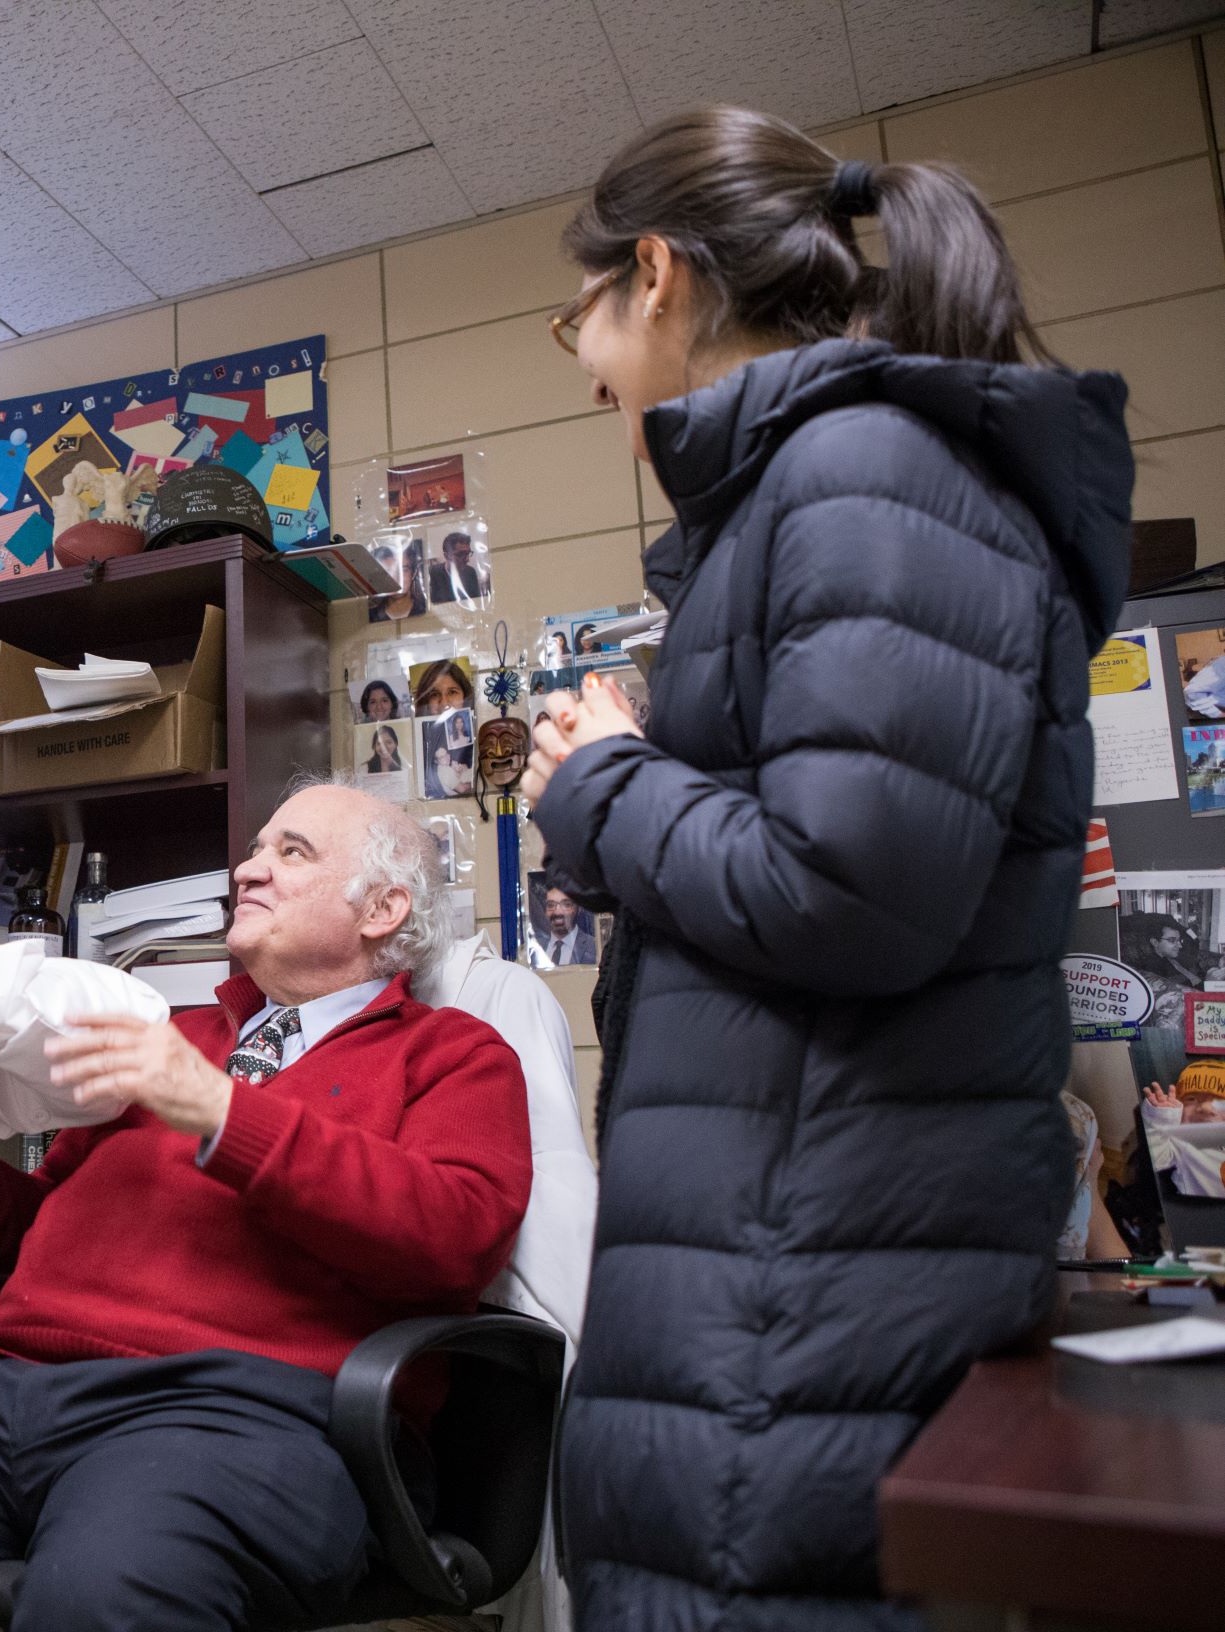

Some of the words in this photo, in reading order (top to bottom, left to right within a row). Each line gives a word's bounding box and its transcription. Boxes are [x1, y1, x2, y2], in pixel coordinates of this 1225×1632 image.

[37, 741, 75, 758] HANDLE
[77, 735, 102, 752] WITH
[104, 732, 131, 748] CARE
[1082, 961, 1103, 972] 2019
[1063, 969, 1131, 990] SUPPORT
[1065, 983, 1129, 1003] OUNDED
[1071, 997, 1127, 1017] RRIORS
